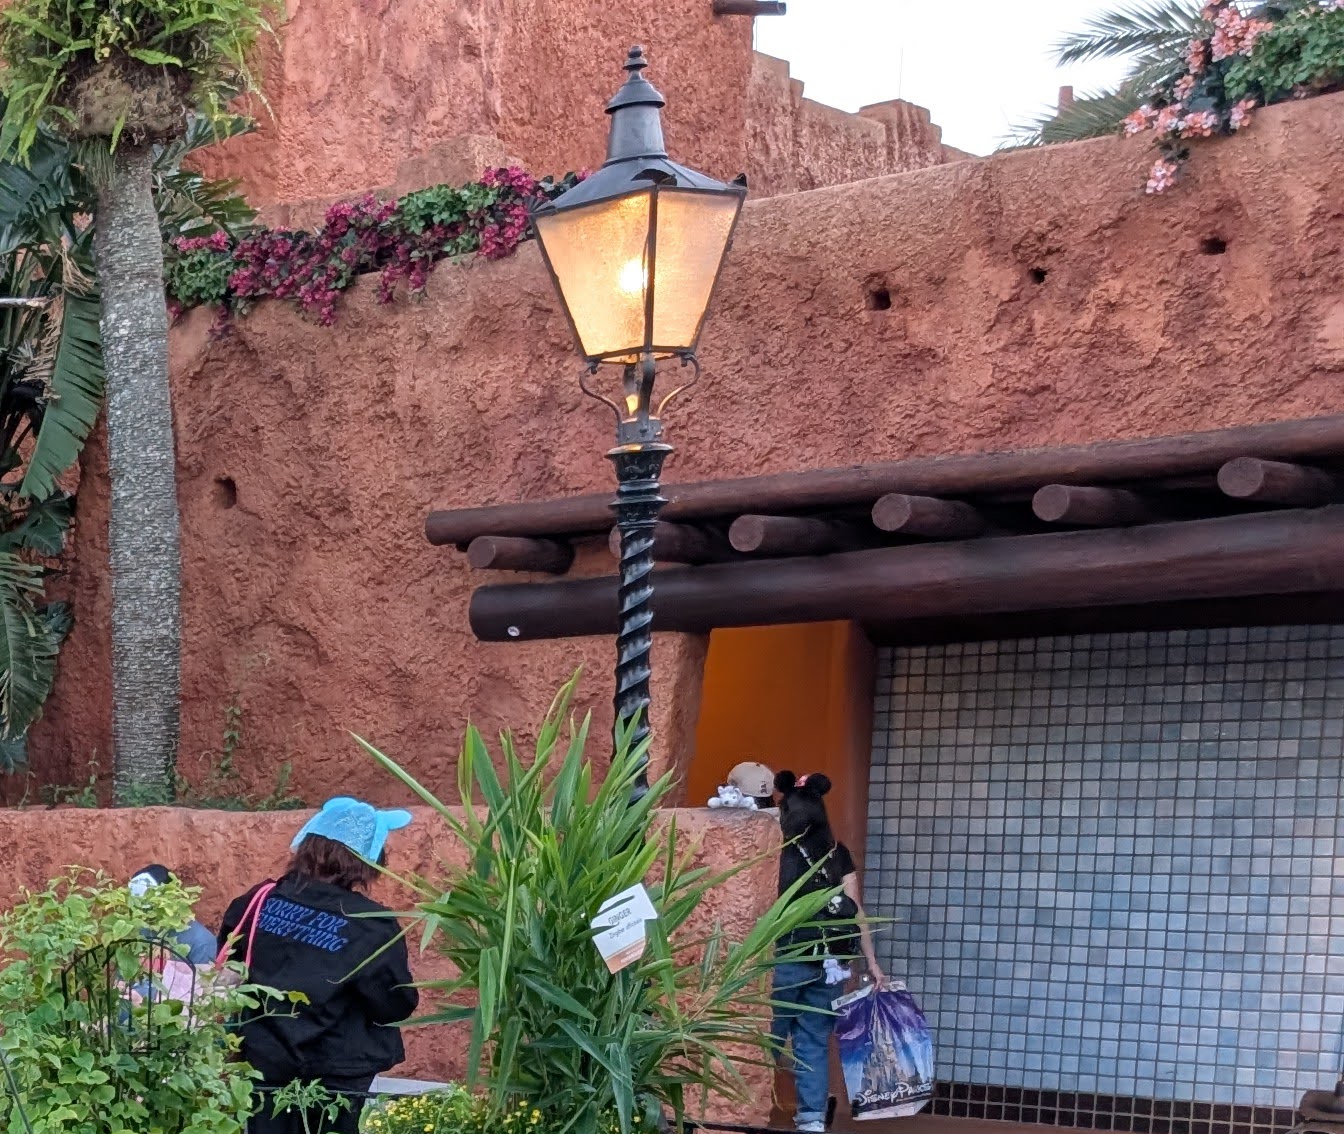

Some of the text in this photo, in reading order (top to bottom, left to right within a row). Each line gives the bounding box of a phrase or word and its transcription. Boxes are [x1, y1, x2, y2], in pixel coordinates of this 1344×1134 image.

[262, 897, 349, 933] SORRY FOR
[608, 908, 632, 925] GINGER
